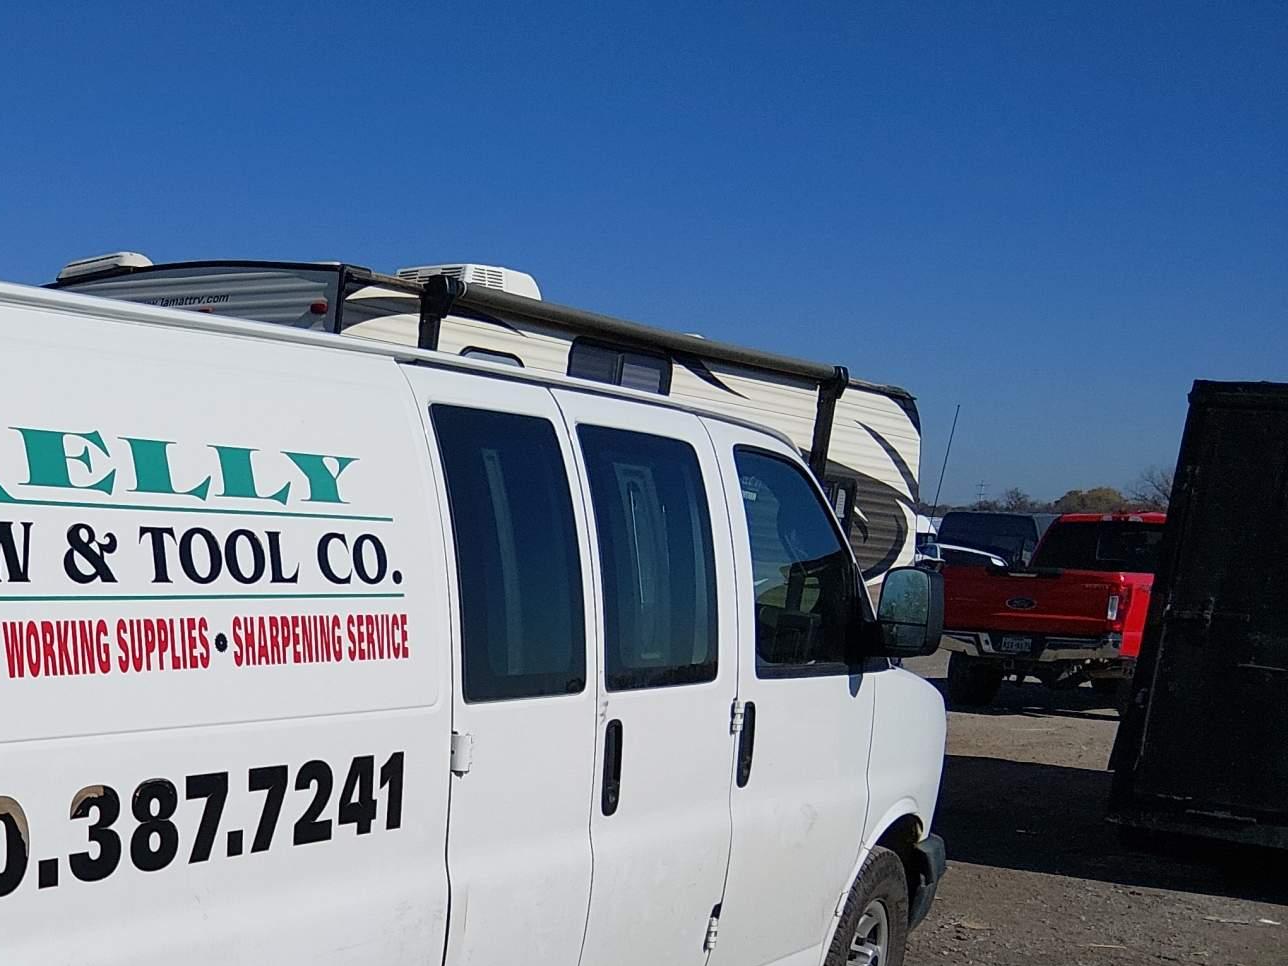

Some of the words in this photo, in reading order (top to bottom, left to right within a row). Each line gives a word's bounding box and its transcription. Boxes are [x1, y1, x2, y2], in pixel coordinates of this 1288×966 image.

[63, 522, 119, 584] &
[139, 525, 300, 586] TOOL
[317, 531, 404, 586] CO.
[2, 617, 111, 679] WORKING
[116, 615, 211, 674] SUPPLIES
[232, 613, 343, 667] SHARPENING
[347, 612, 410, 662] SERVICE
